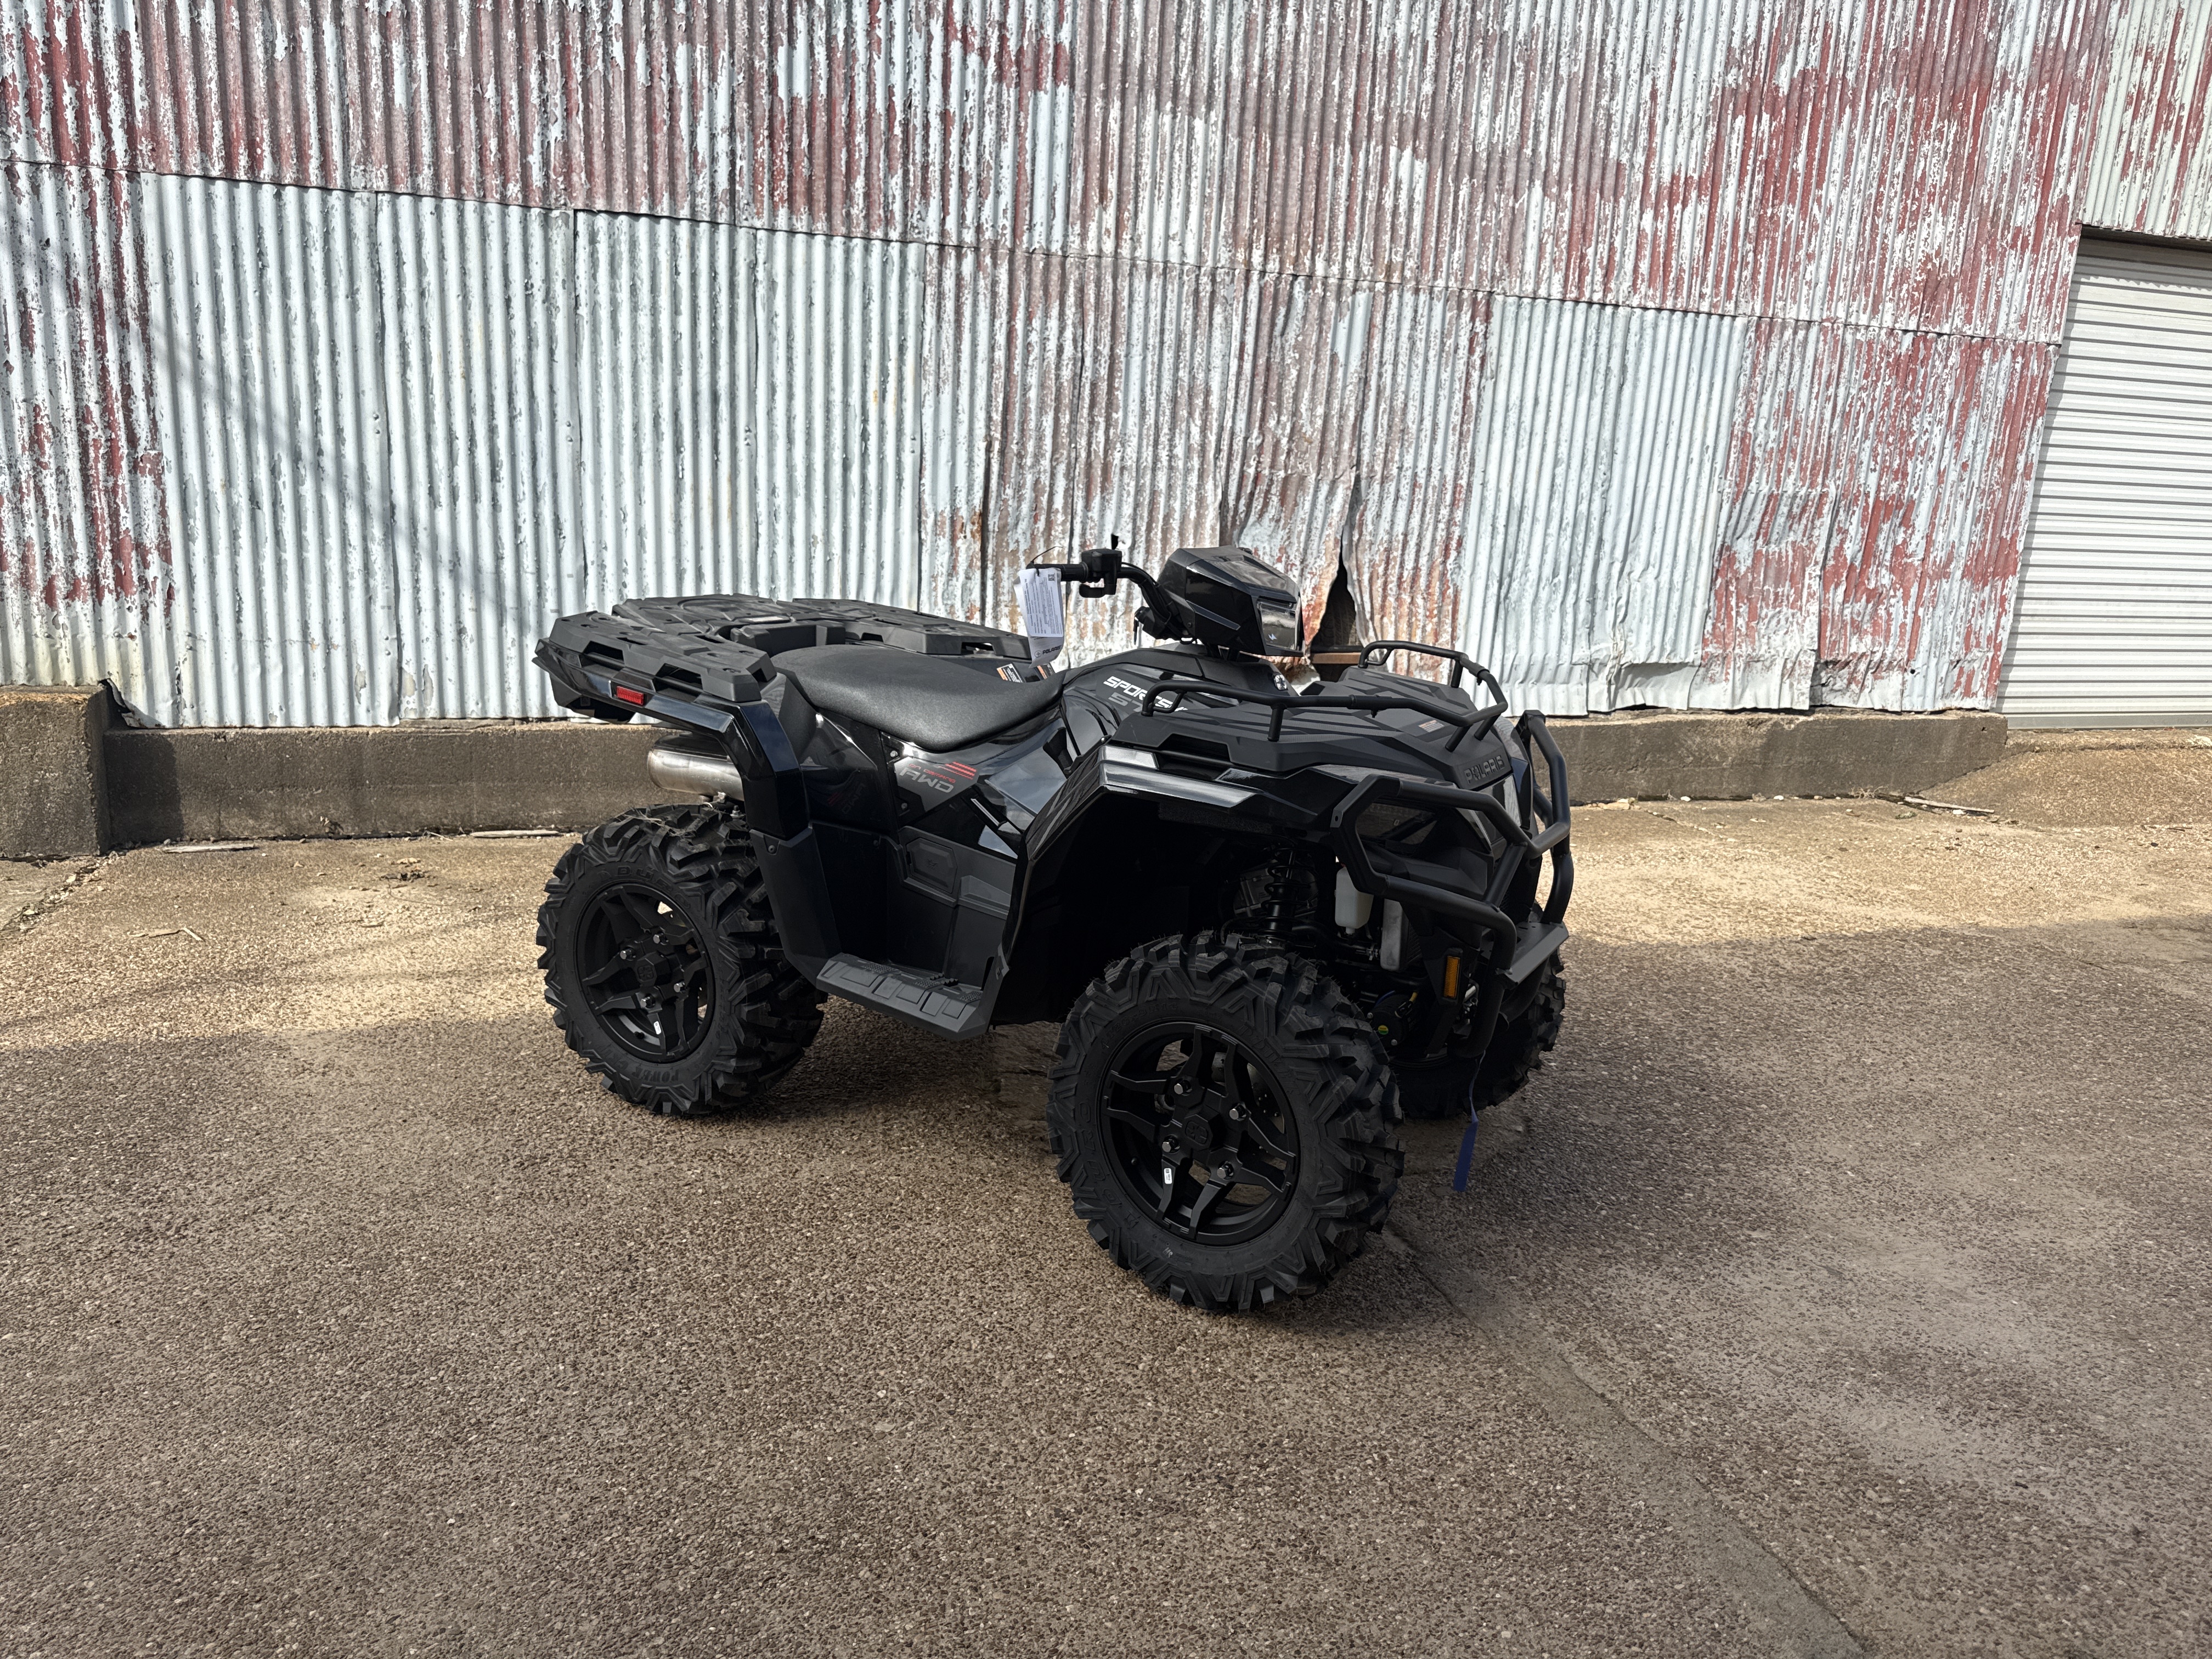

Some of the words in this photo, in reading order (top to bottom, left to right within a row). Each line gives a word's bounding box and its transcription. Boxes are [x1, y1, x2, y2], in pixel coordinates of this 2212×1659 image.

[1042, 645, 1062, 655] POLARIS
[1108, 692, 1143, 713] 57
[899, 768, 954, 793] AWD
[1464, 755, 1505, 783] POLARIS
[615, 865, 691, 909] DURO
[1078, 1100, 1122, 1208] DURO
